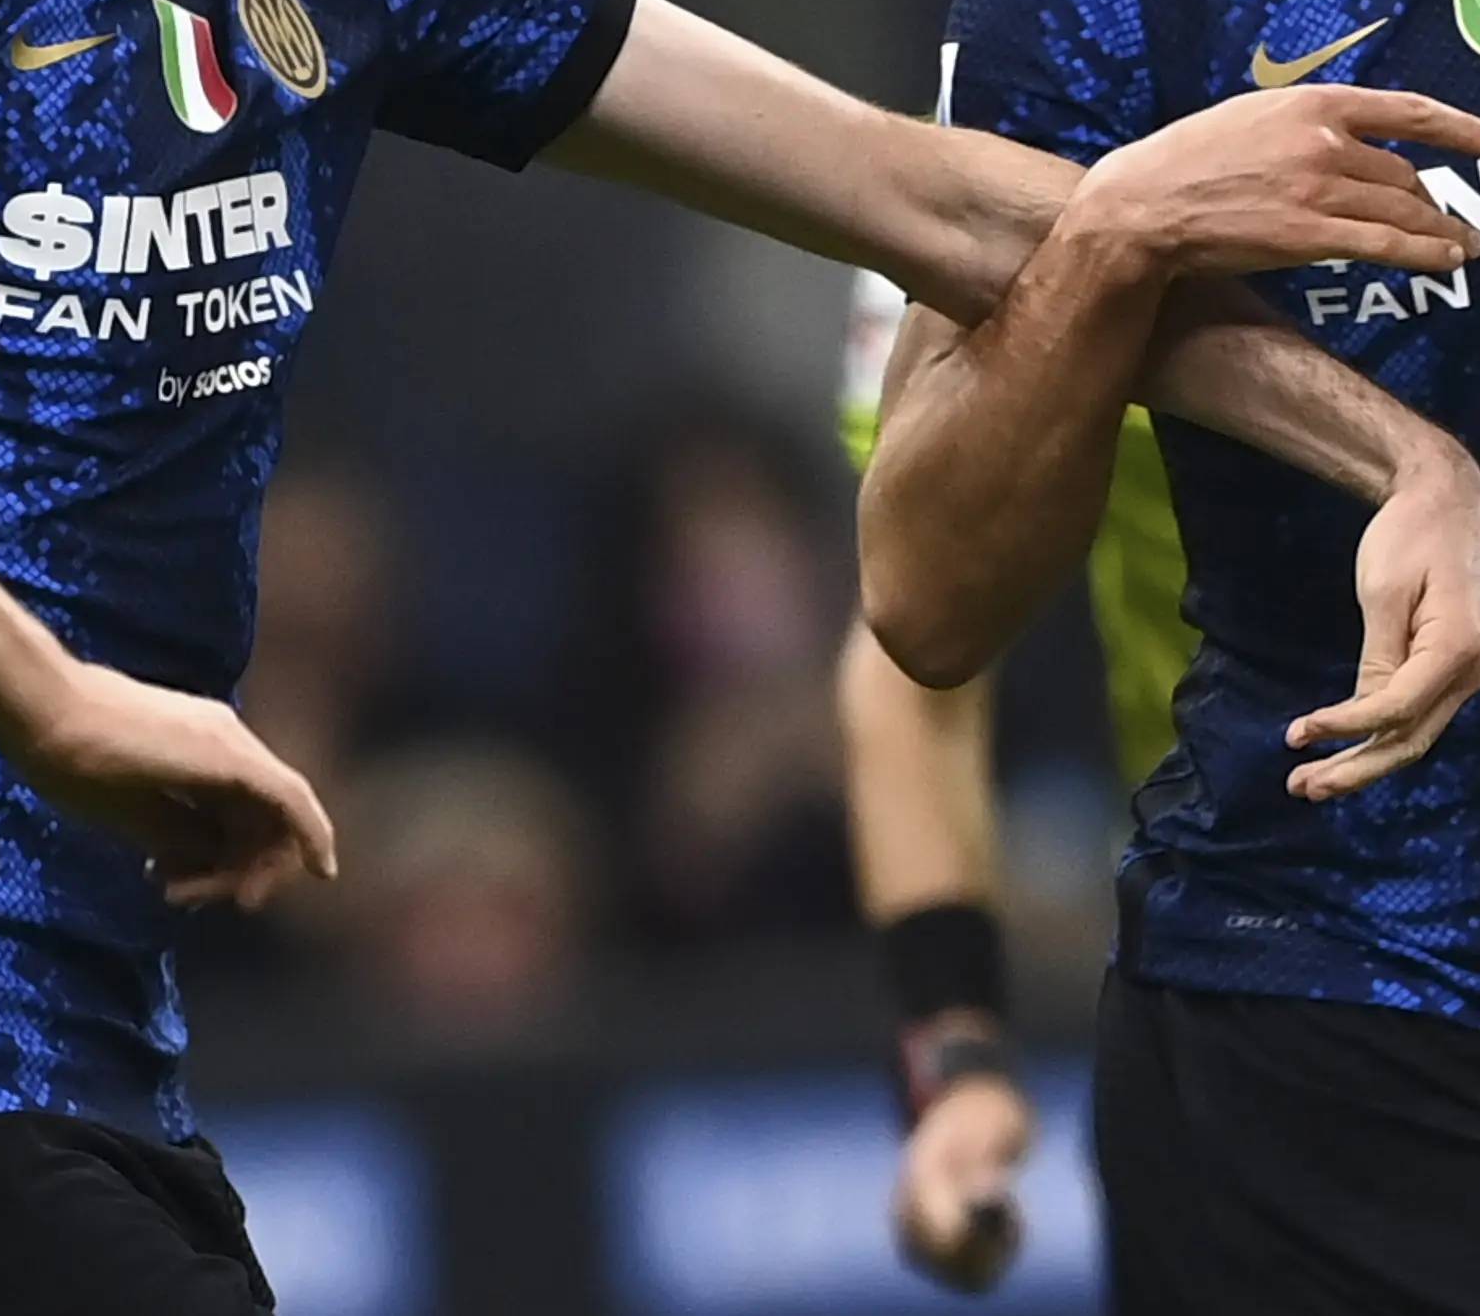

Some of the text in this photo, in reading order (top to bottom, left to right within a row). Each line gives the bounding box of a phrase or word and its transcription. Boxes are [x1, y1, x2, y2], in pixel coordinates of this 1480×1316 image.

[176, 269, 314, 337] TOKEN
[1305, 259, 1470, 326] FAN
[158, 367, 192, 407] by
